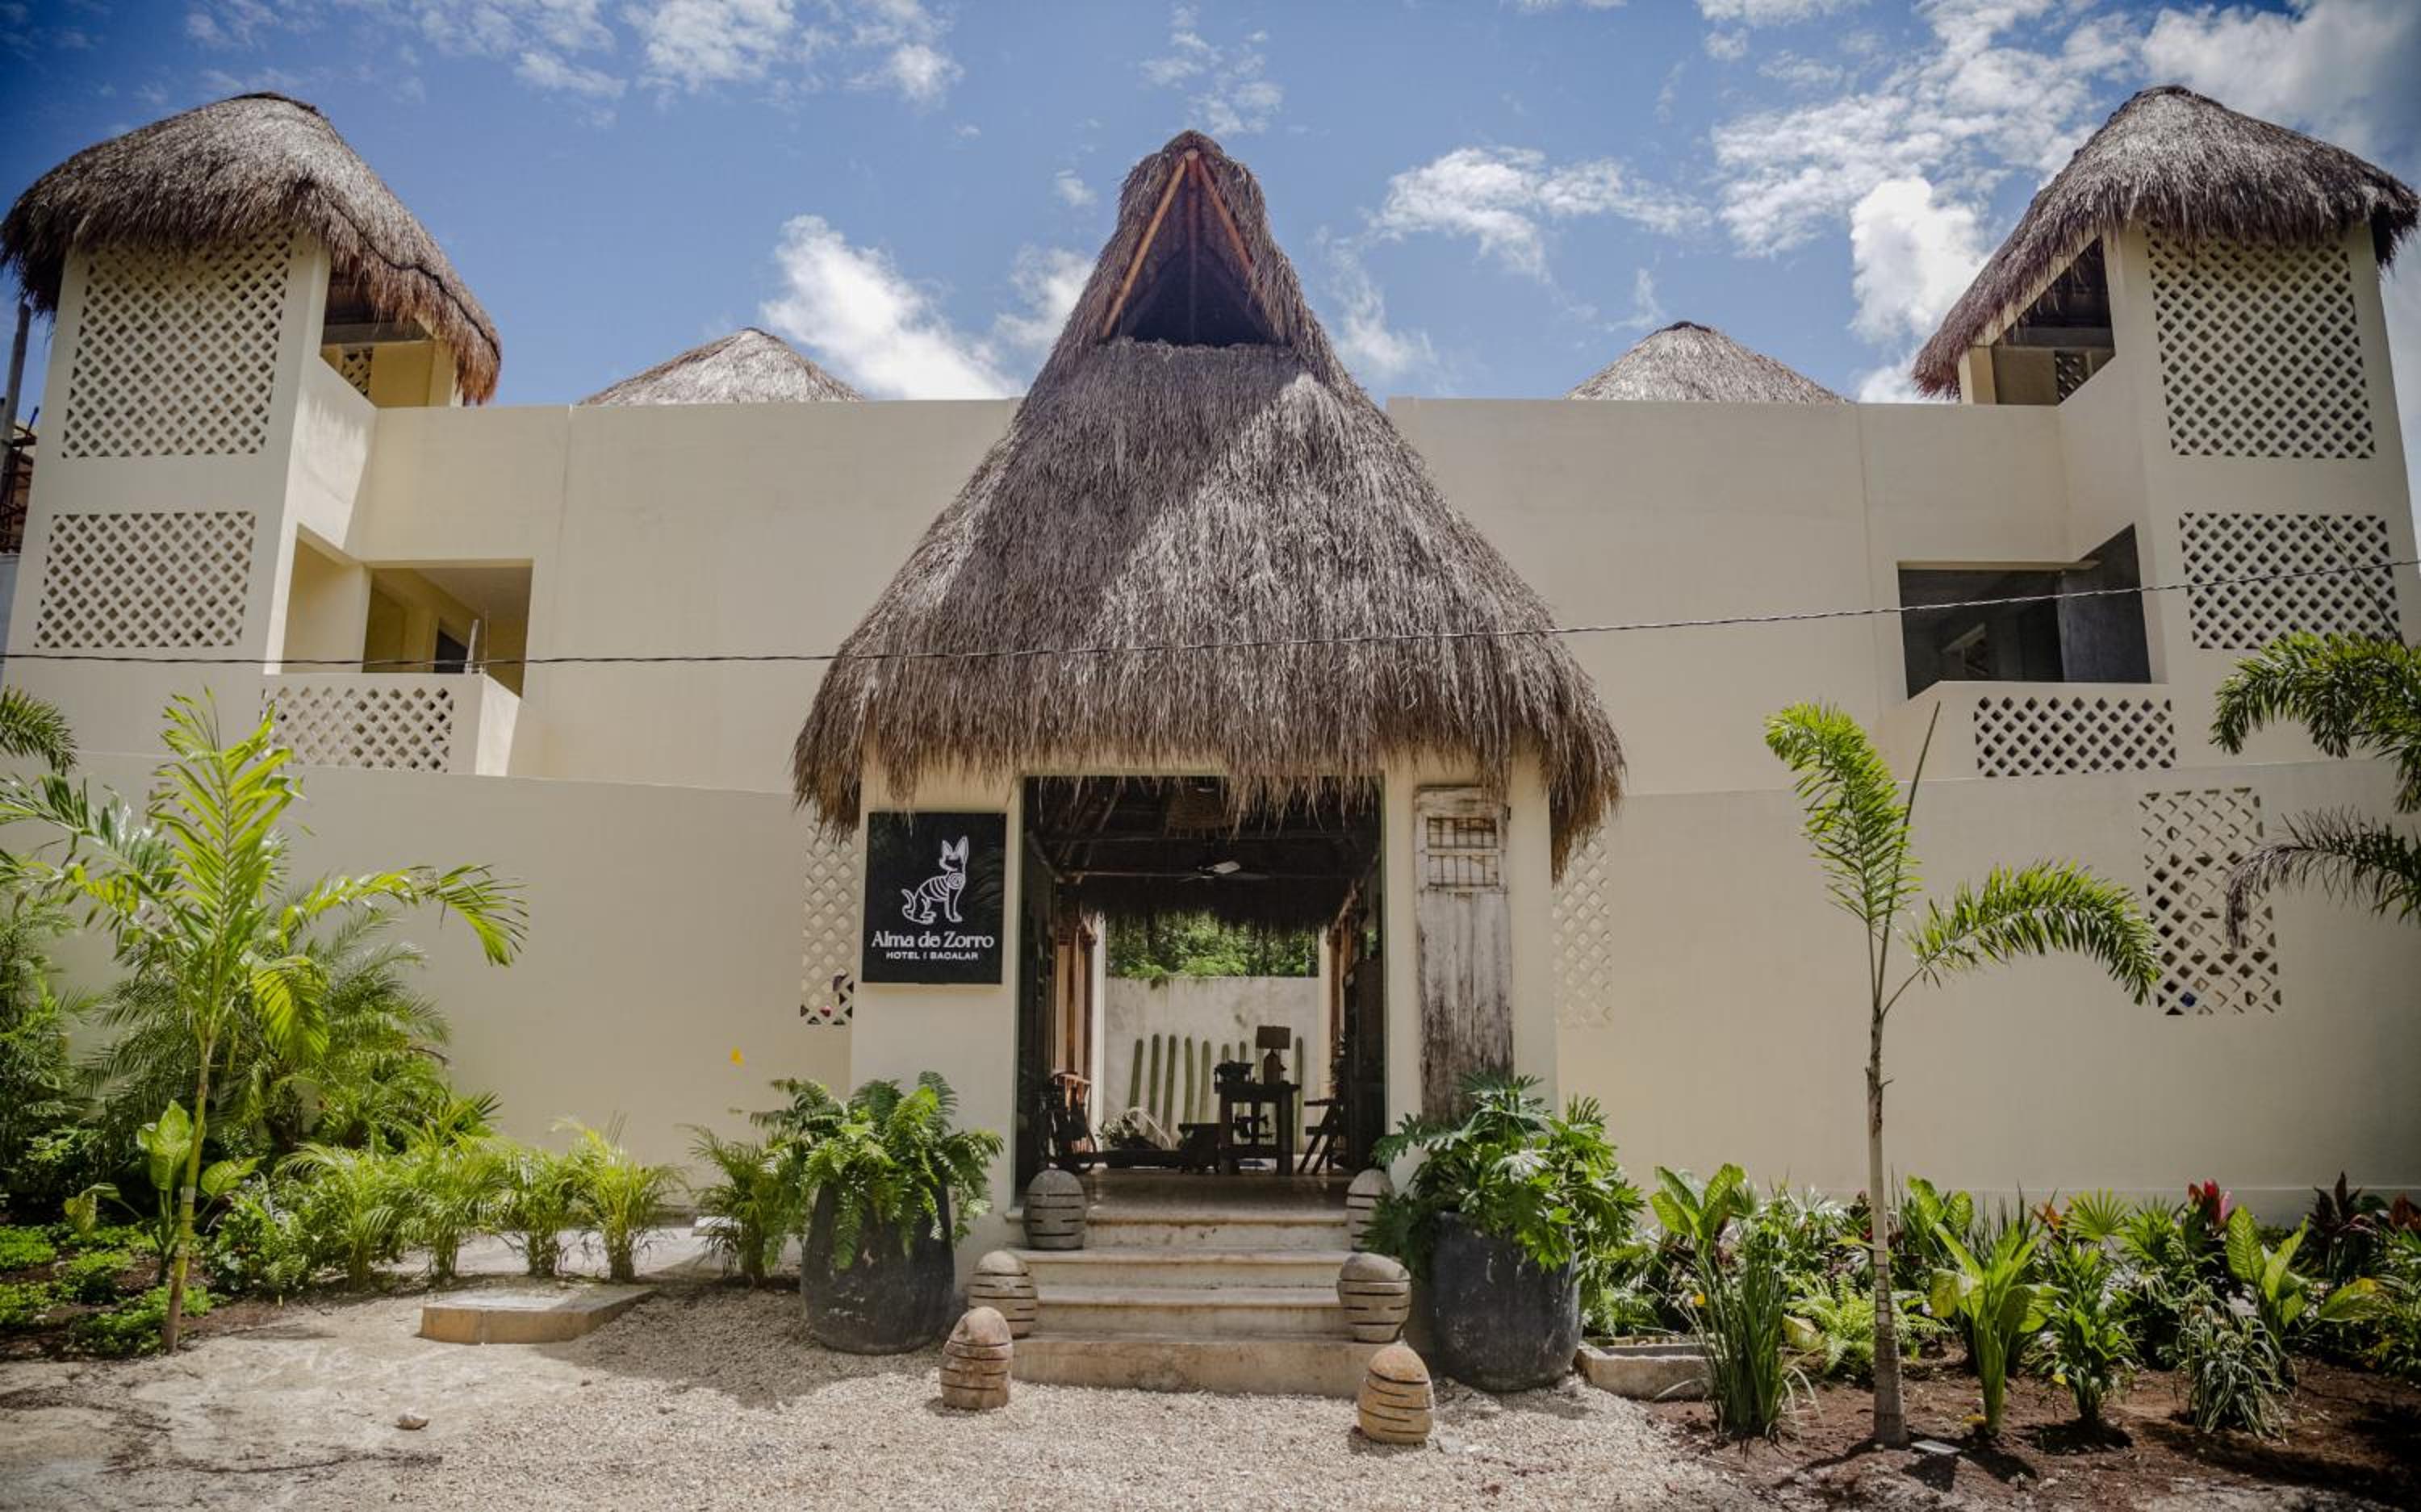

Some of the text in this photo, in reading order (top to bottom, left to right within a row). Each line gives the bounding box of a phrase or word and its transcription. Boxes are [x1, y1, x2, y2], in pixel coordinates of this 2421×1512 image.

[871, 930, 994, 948] Alma de Zorro
[886, 951, 979, 960] HOTEL BACALAR
